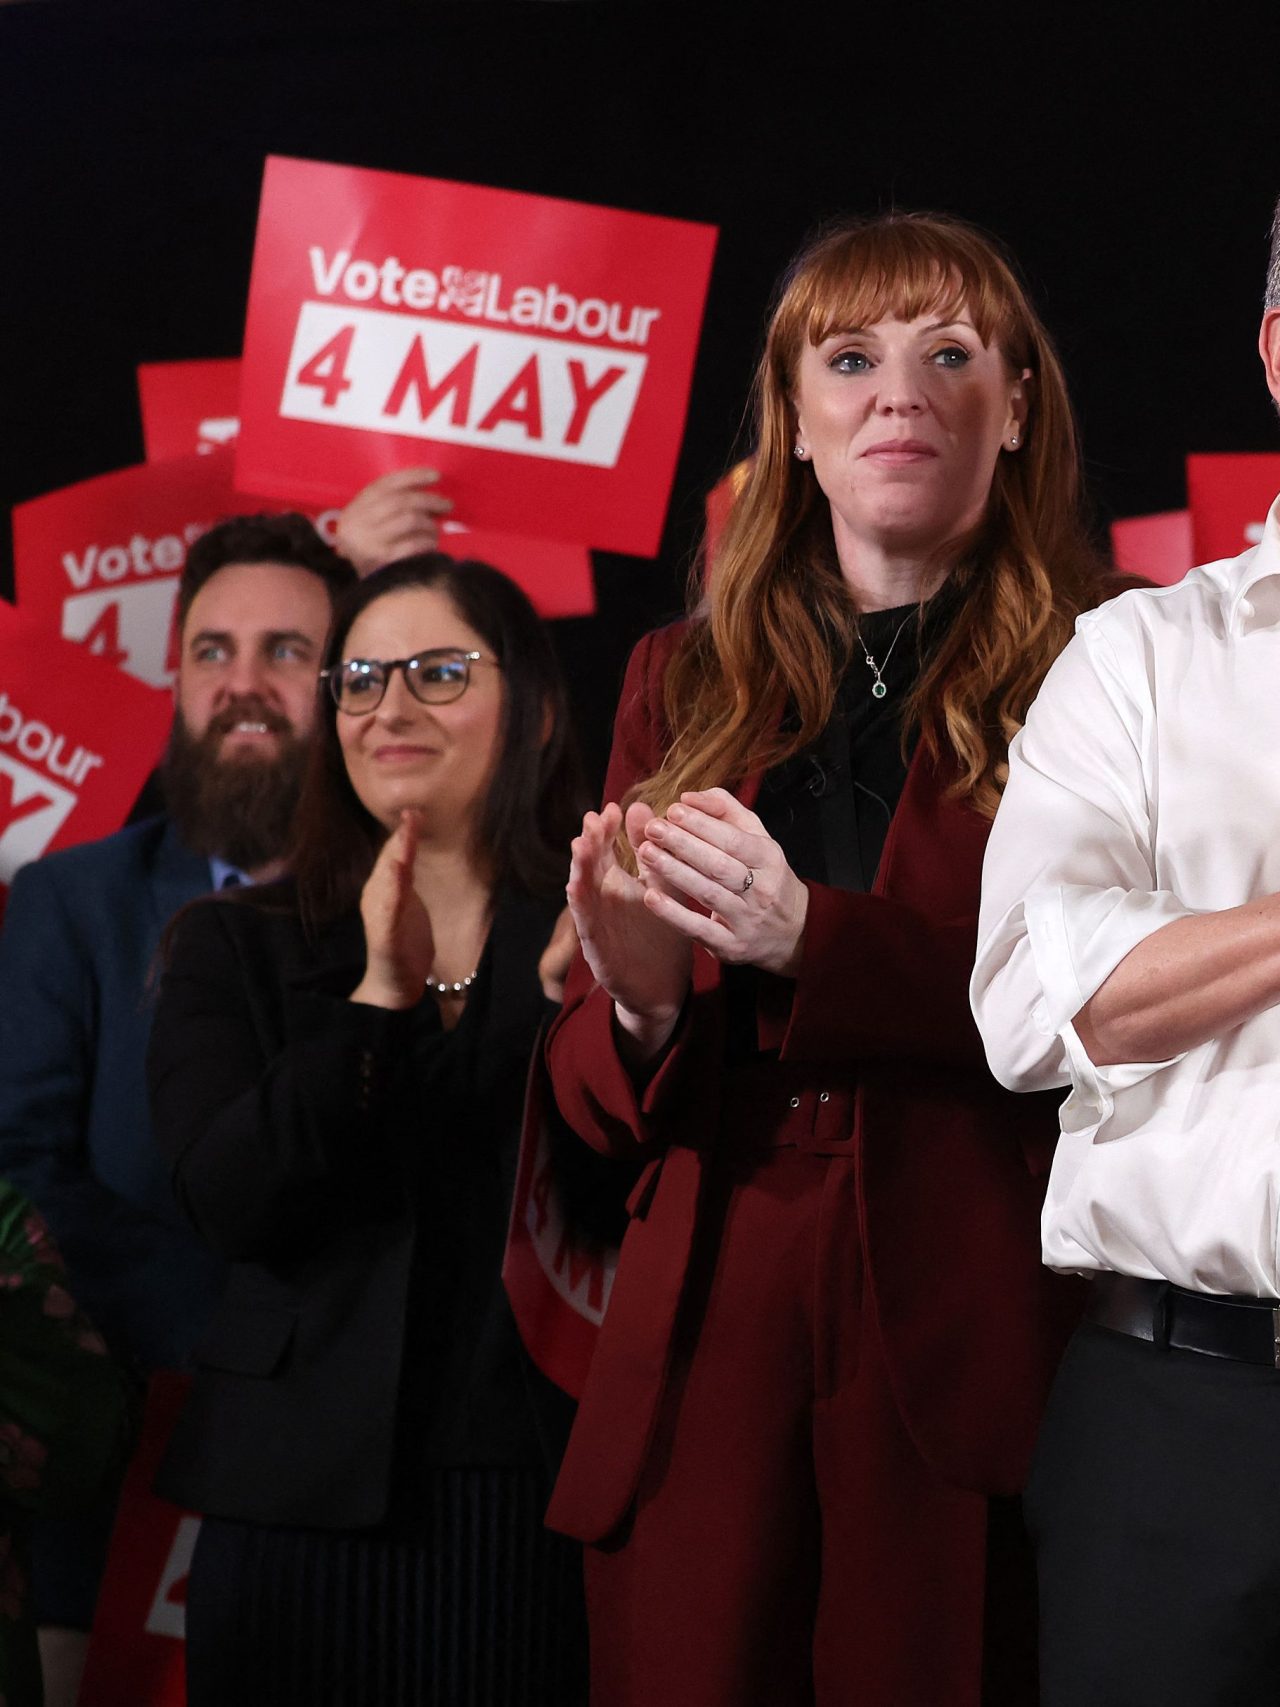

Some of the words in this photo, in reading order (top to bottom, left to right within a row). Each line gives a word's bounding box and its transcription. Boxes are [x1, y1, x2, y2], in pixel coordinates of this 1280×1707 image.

[309, 245, 440, 310] Vote
[484, 273, 661, 346] Labour
[296, 324, 357, 409] 4
[383, 330, 628, 447] MAY
[62, 533, 185, 589] Vote
